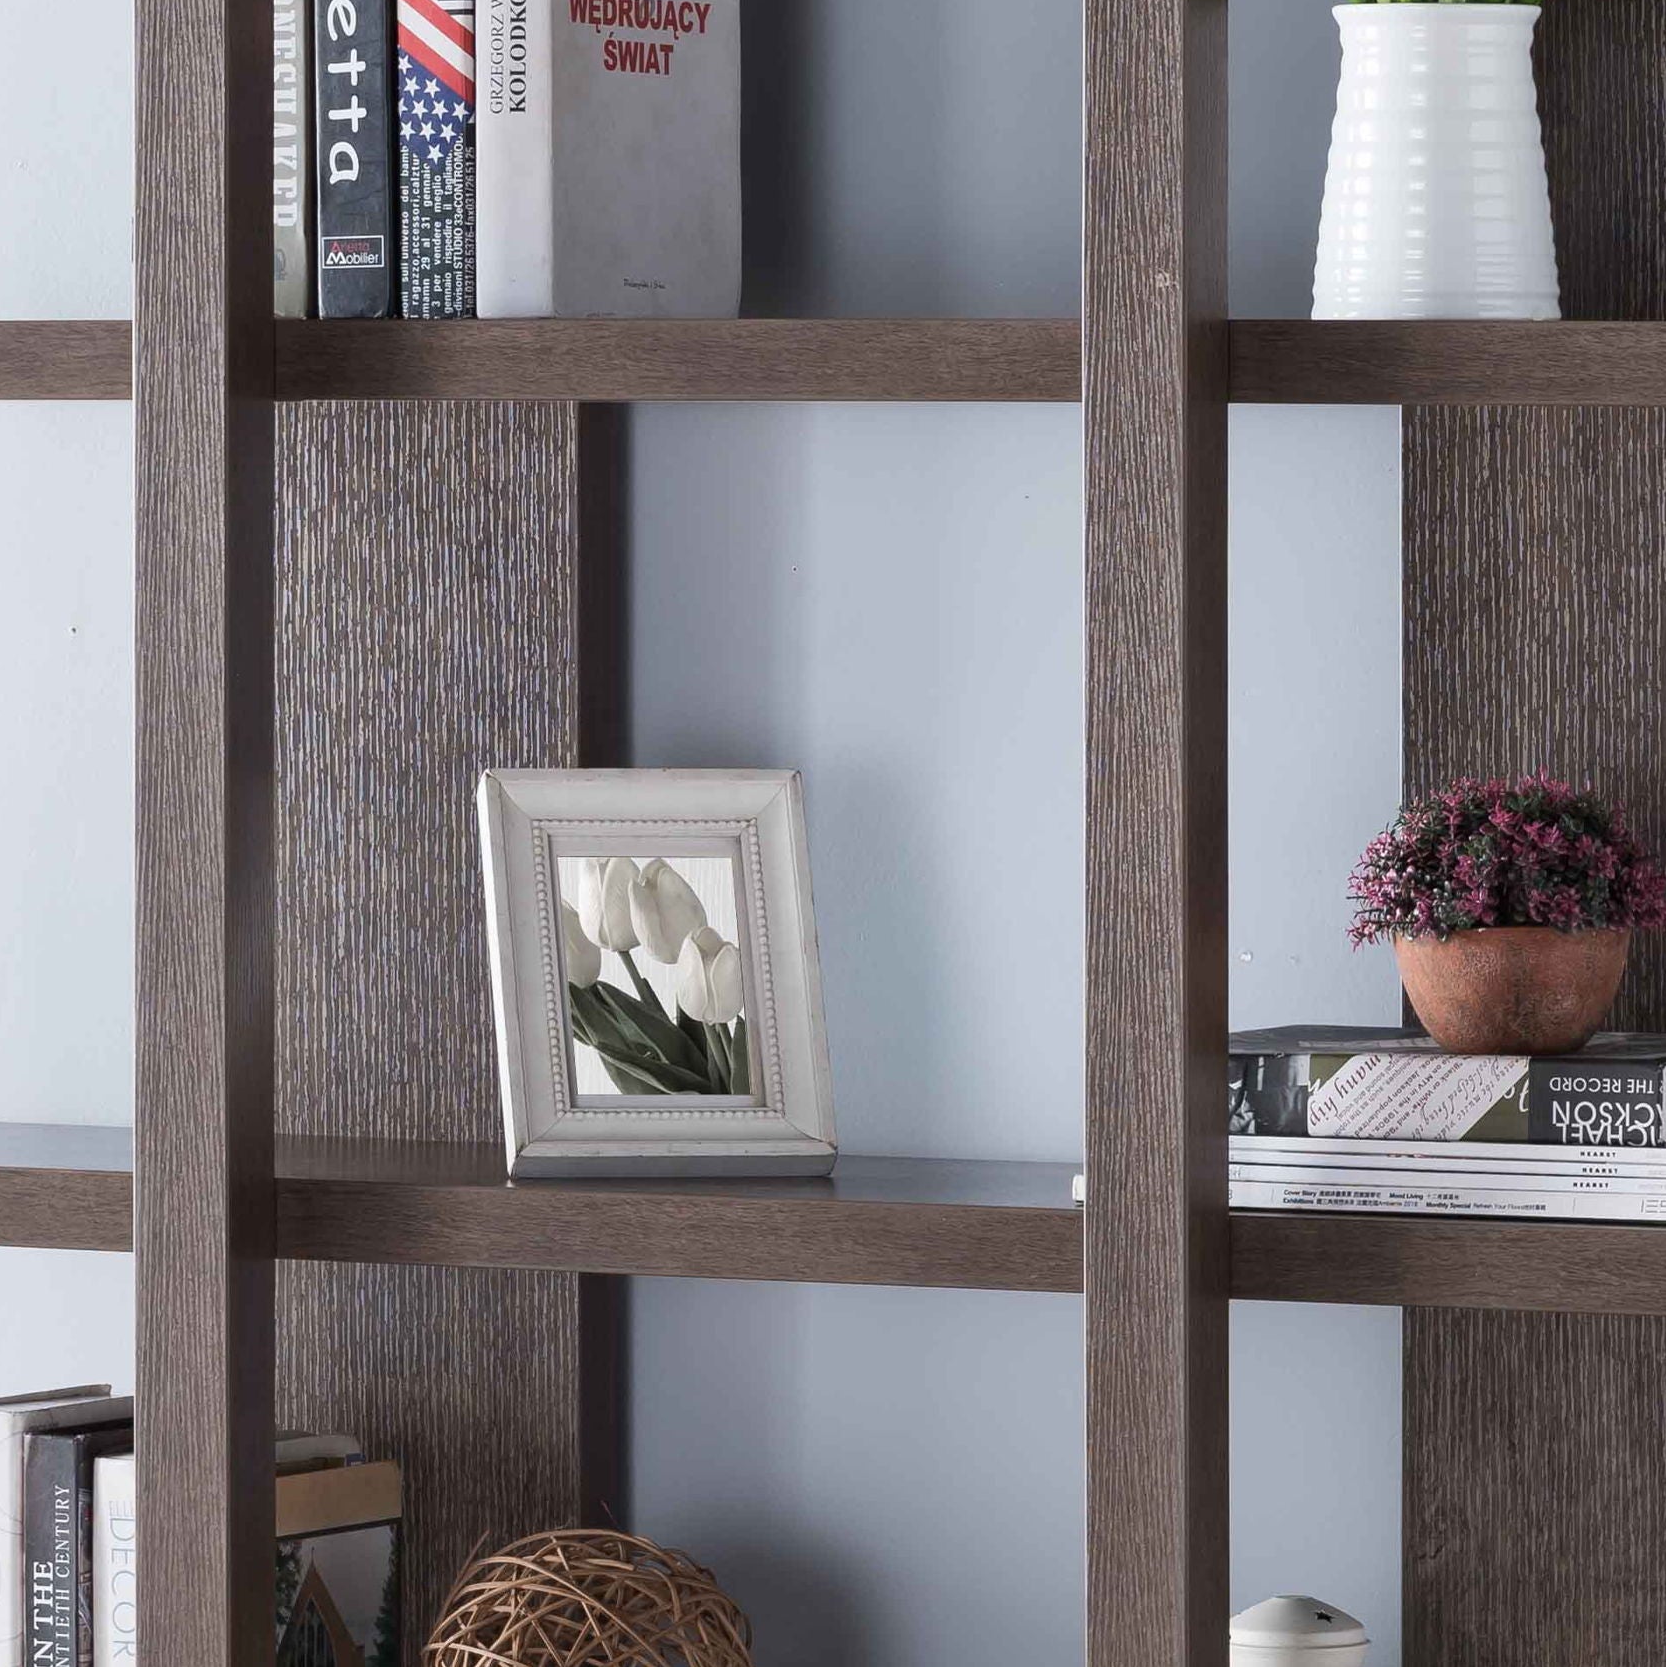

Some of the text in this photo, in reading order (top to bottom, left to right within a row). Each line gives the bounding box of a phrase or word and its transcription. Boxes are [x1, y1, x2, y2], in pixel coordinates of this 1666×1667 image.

[489, 14, 504, 114] GRZEGORZ
[603, 31, 675, 76] ŚWIAT
[431, 174, 444, 213] meglio
[325, 251, 379, 265] Mobilier
[432, 221, 441, 265] vendere
[442, 218, 454, 264] rispedire
[453, 228, 463, 269] STUDIO
[433, 273, 443, 292] per
[442, 272, 454, 314] gennaio
[1334, 1055, 1381, 1099] many
[1549, 1077, 1621, 1094] RECORD
[1627, 1079, 1654, 1094] THE
[1556, 1123, 1663, 1147] ICHAEL
[54, 1484, 71, 1579] CENTURY
[32, 1561, 54, 1631] THE
